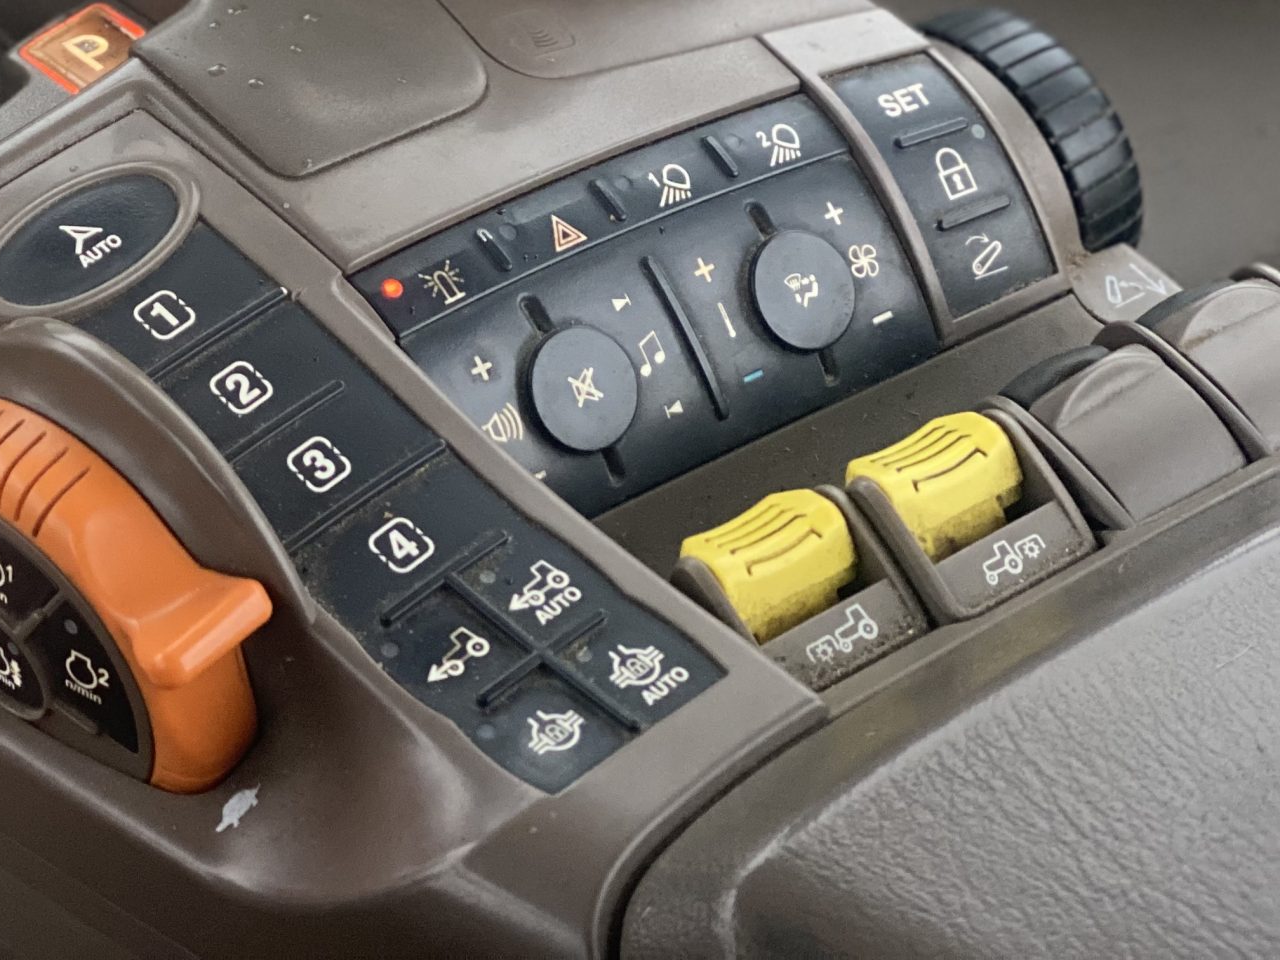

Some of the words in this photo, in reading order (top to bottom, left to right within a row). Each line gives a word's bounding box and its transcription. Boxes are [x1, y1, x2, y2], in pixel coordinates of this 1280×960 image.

[62, 34, 109, 71] P
[877, 84, 930, 117] SET
[755, 131, 771, 148] 2
[647, 172, 660, 188] 1
[78, 234, 122, 268] AUTO
[150, 302, 179, 327] 1
[225, 374, 261, 403] 2
[303, 450, 336, 479] 3
[386, 529, 420, 559] 4
[6, 565, 13, 583] 1
[535, 586, 582, 626] AUTO
[65, 679, 102, 705] n/min
[97, 668, 110, 687] 2
[641, 666, 689, 706] AUTO
